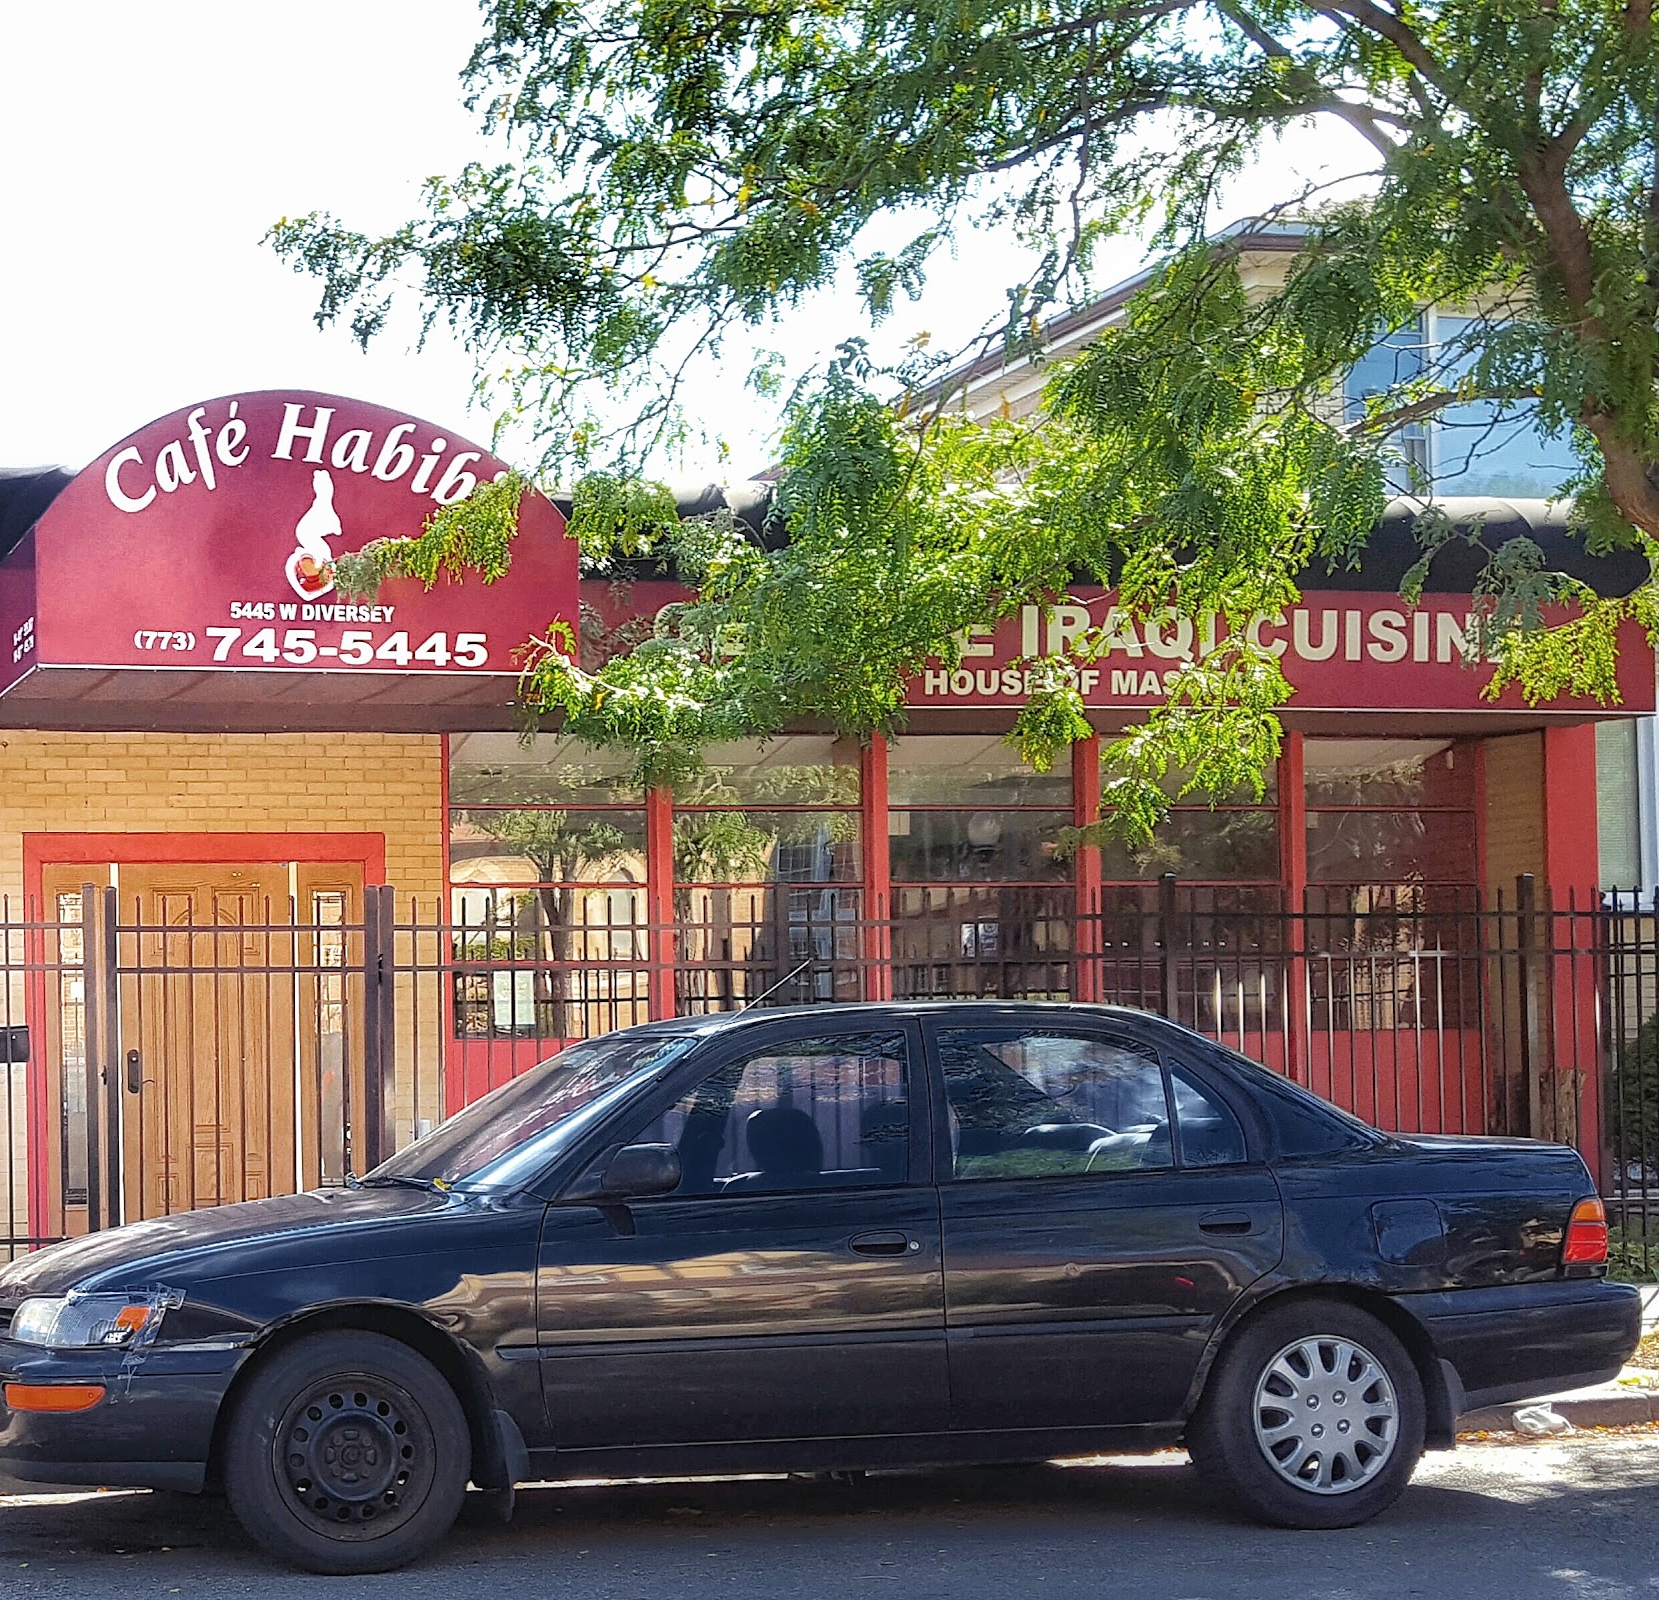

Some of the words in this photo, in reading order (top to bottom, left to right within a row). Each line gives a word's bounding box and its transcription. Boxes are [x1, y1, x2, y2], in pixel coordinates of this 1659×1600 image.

[104, 400, 251, 513] Café
[271, 401, 508, 505] Habib
[230, 602, 276, 620] 5445
[279, 603, 298, 621] W
[301, 604, 395, 623] DIVERSEY
[1021, 604, 1217, 662] IRAQI
[133, 630, 196, 652] (773)
[205, 627, 489, 669] 745-5445
